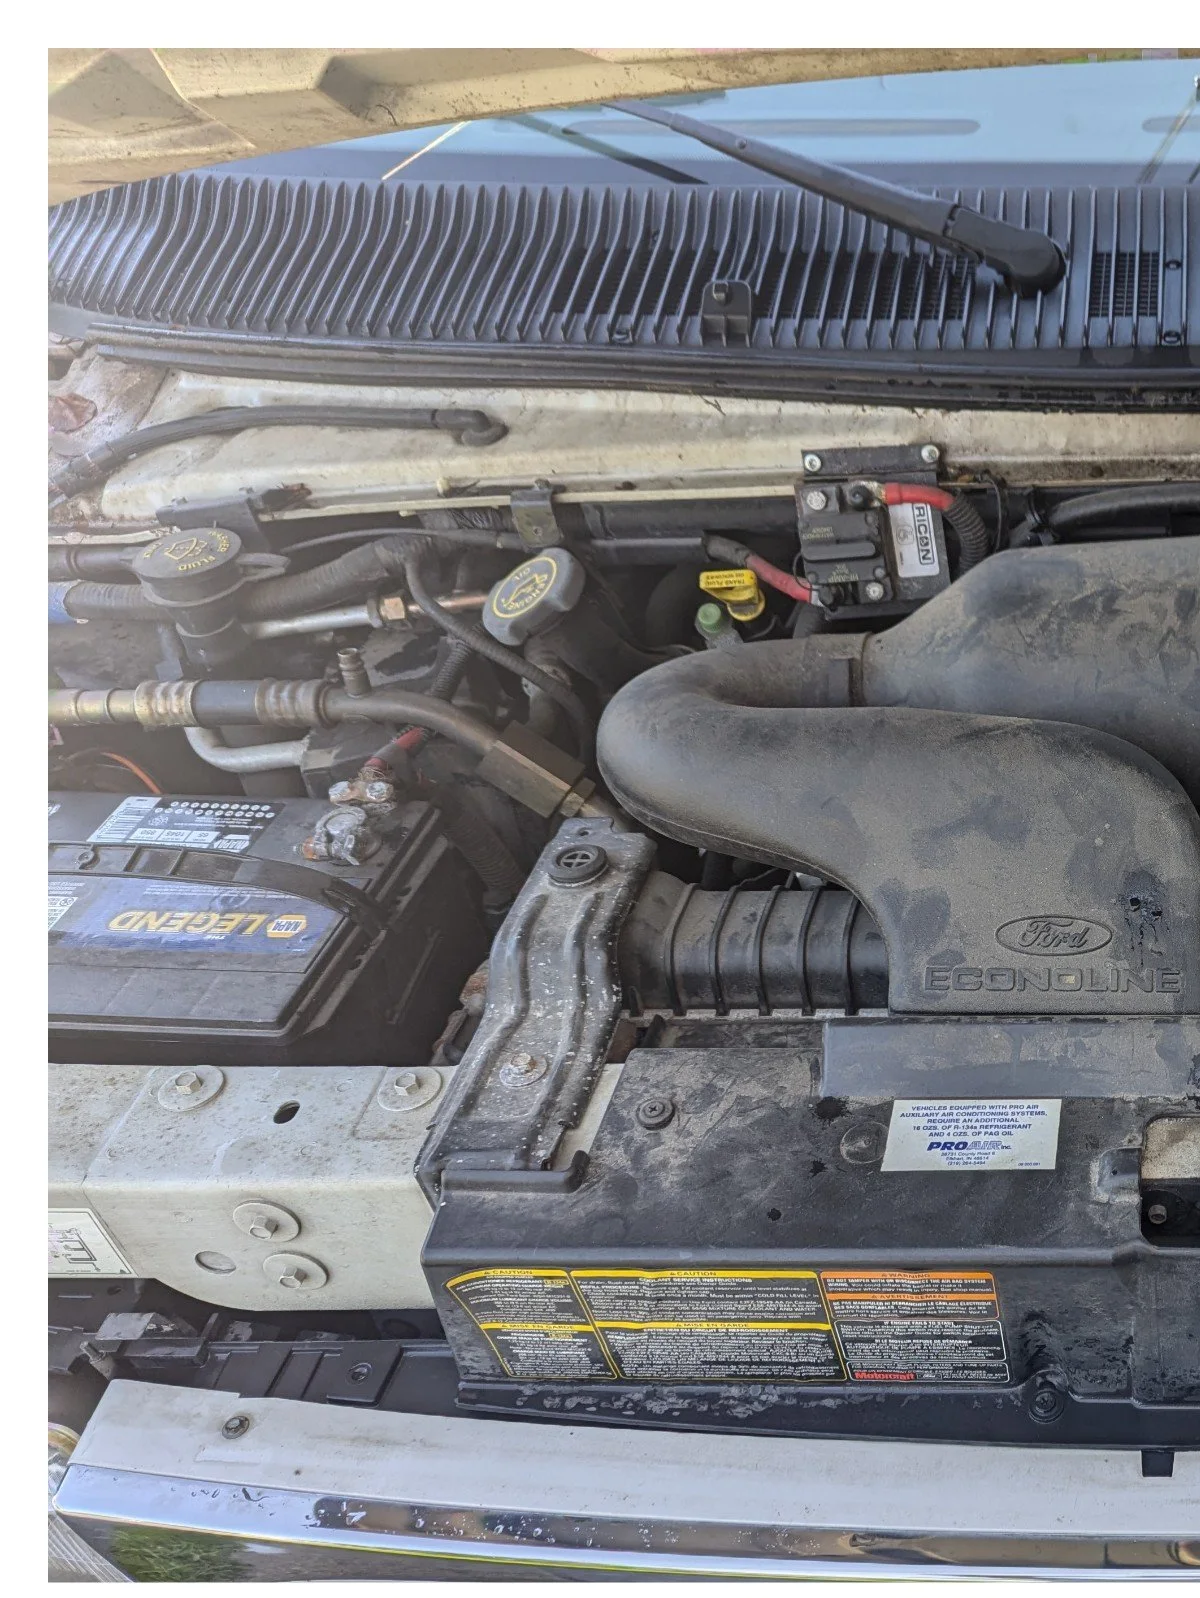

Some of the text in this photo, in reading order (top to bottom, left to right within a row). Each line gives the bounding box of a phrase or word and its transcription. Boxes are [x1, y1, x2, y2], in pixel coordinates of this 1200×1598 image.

[914, 504, 932, 562] RICON
[178, 554, 217, 572] FLUID
[514, 567, 532, 581] OIL
[218, 839, 248, 850] NAPA
[108, 911, 303, 935] NAPA LEGEND
[1017, 919, 1091, 948] Ford
[924, 965, 1182, 994] ECONOLINE
[854, 1371, 915, 1380] Motorcraft
